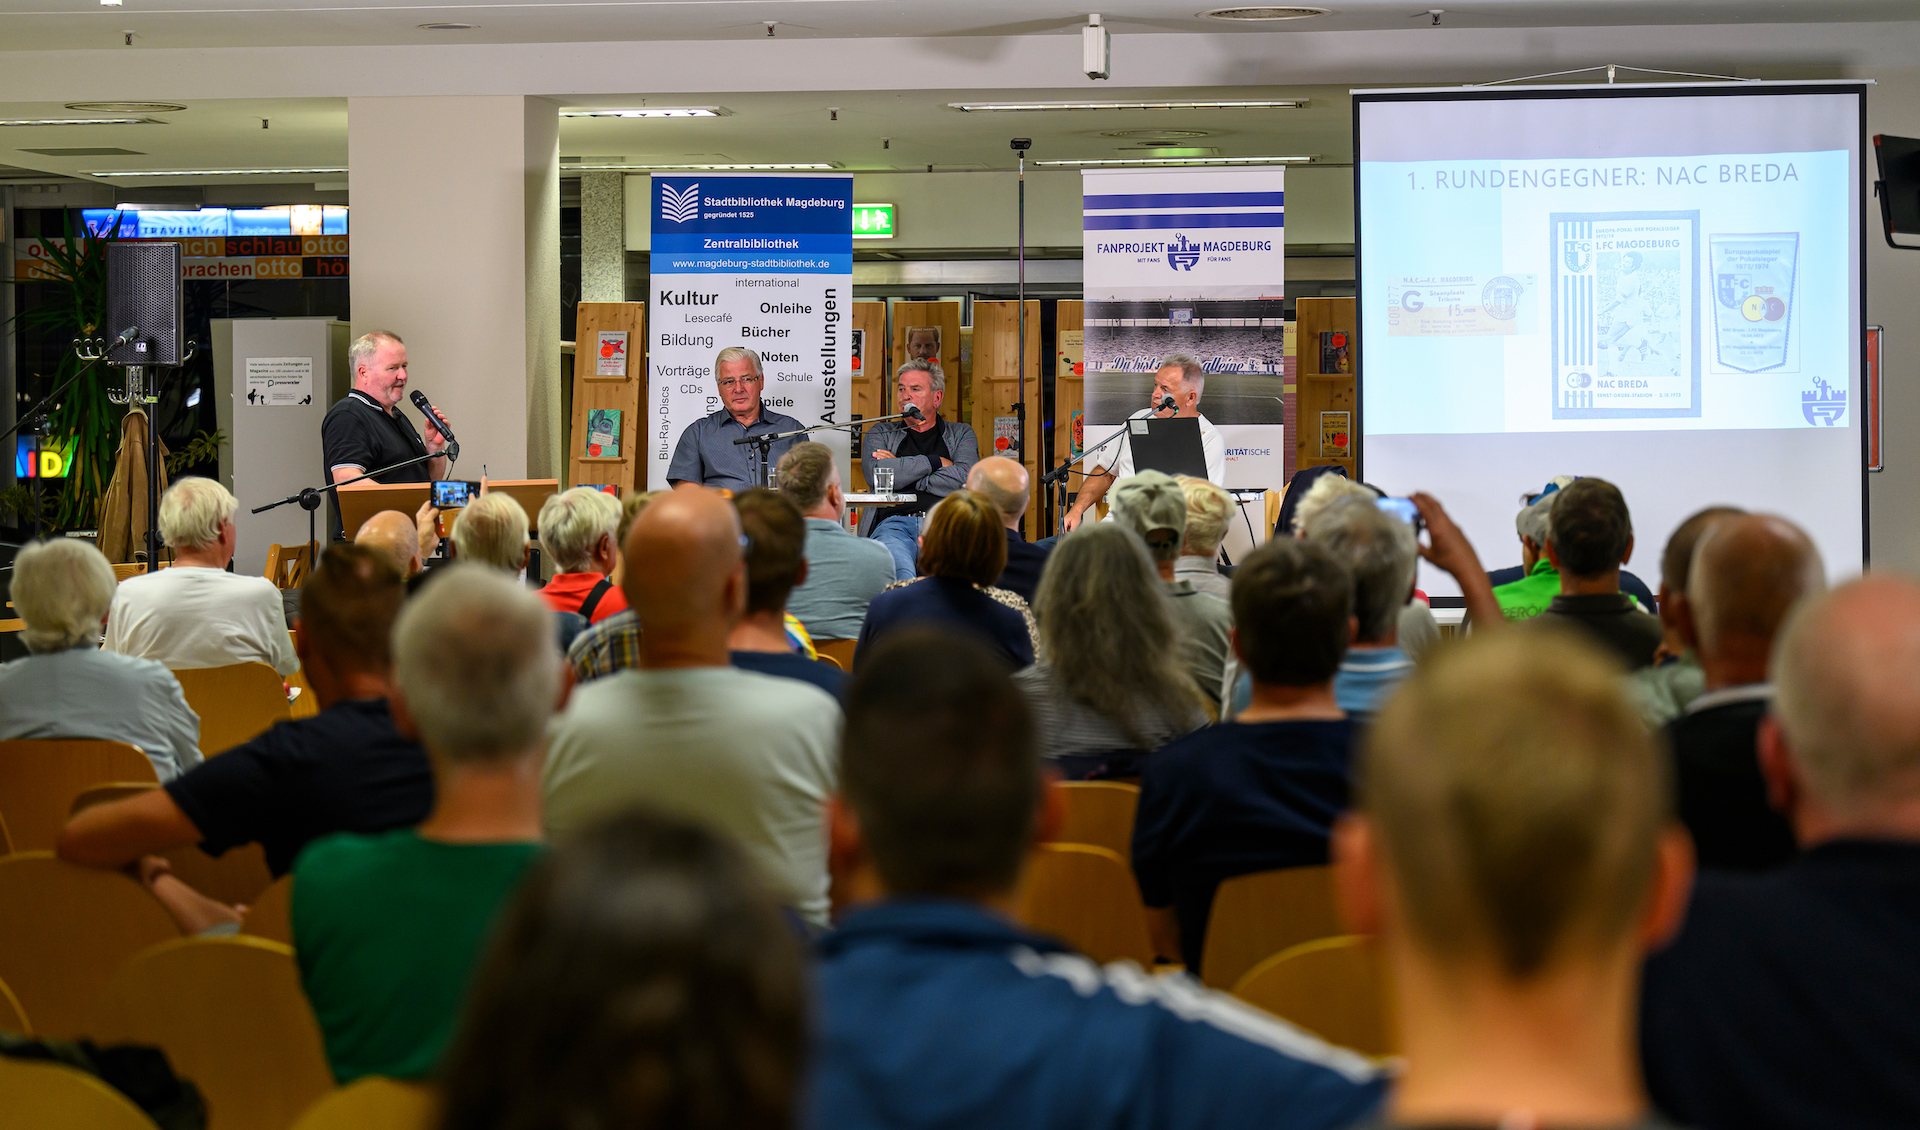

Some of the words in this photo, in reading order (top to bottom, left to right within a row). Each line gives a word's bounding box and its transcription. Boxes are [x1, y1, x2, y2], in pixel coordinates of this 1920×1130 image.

[1407, 171, 1425, 190] 1.
[1435, 168, 1646, 190] RUNDENGEGNER:
[1657, 165, 1708, 186] NAC
[1719, 163, 1799, 184] BREDA
[704, 197, 783, 207] Stadtbibliothek
[785, 197, 845, 209] Magdeburg
[704, 211, 738, 219] gegründet
[226, 237, 301, 255] schlau
[303, 237, 348, 254] otto
[703, 238, 799, 249] Zentralbibliothek
[1097, 242, 1165, 254] FANPROJEKT
[1203, 240, 1272, 252] MAGDEBURG
[1596, 241, 1614, 250] 1.FC
[1616, 239, 1680, 249] MAGDEBURG
[1724, 248, 1781, 256] Europapokalspiel
[672, 259, 830, 269] www.magdeburg-stadtbibliothek.de
[1740, 255, 1778, 263] Pokalsieger
[256, 258, 302, 276] otto
[735, 278, 800, 288] international
[660, 290, 719, 306] Kultur
[1401, 290, 1424, 313] G
[759, 302, 812, 314] Onleihe
[684, 312, 733, 323] Lesecafé
[741, 326, 791, 338] Bücher
[661, 333, 714, 349] Bildung
[761, 351, 799, 363] Noten
[820, 288, 840, 425] Ausstellungen
[1201, 356, 1245, 371] alleine
[656, 365, 711, 379] Vorträge
[776, 371, 813, 382] Schule
[680, 384, 703, 394] CDs
[1597, 380, 1615, 388] NAC
[1618, 380, 1649, 388] BREDA
[760, 397, 795, 410] piele
[658, 385, 672, 460] Blu-Ray-Discs
